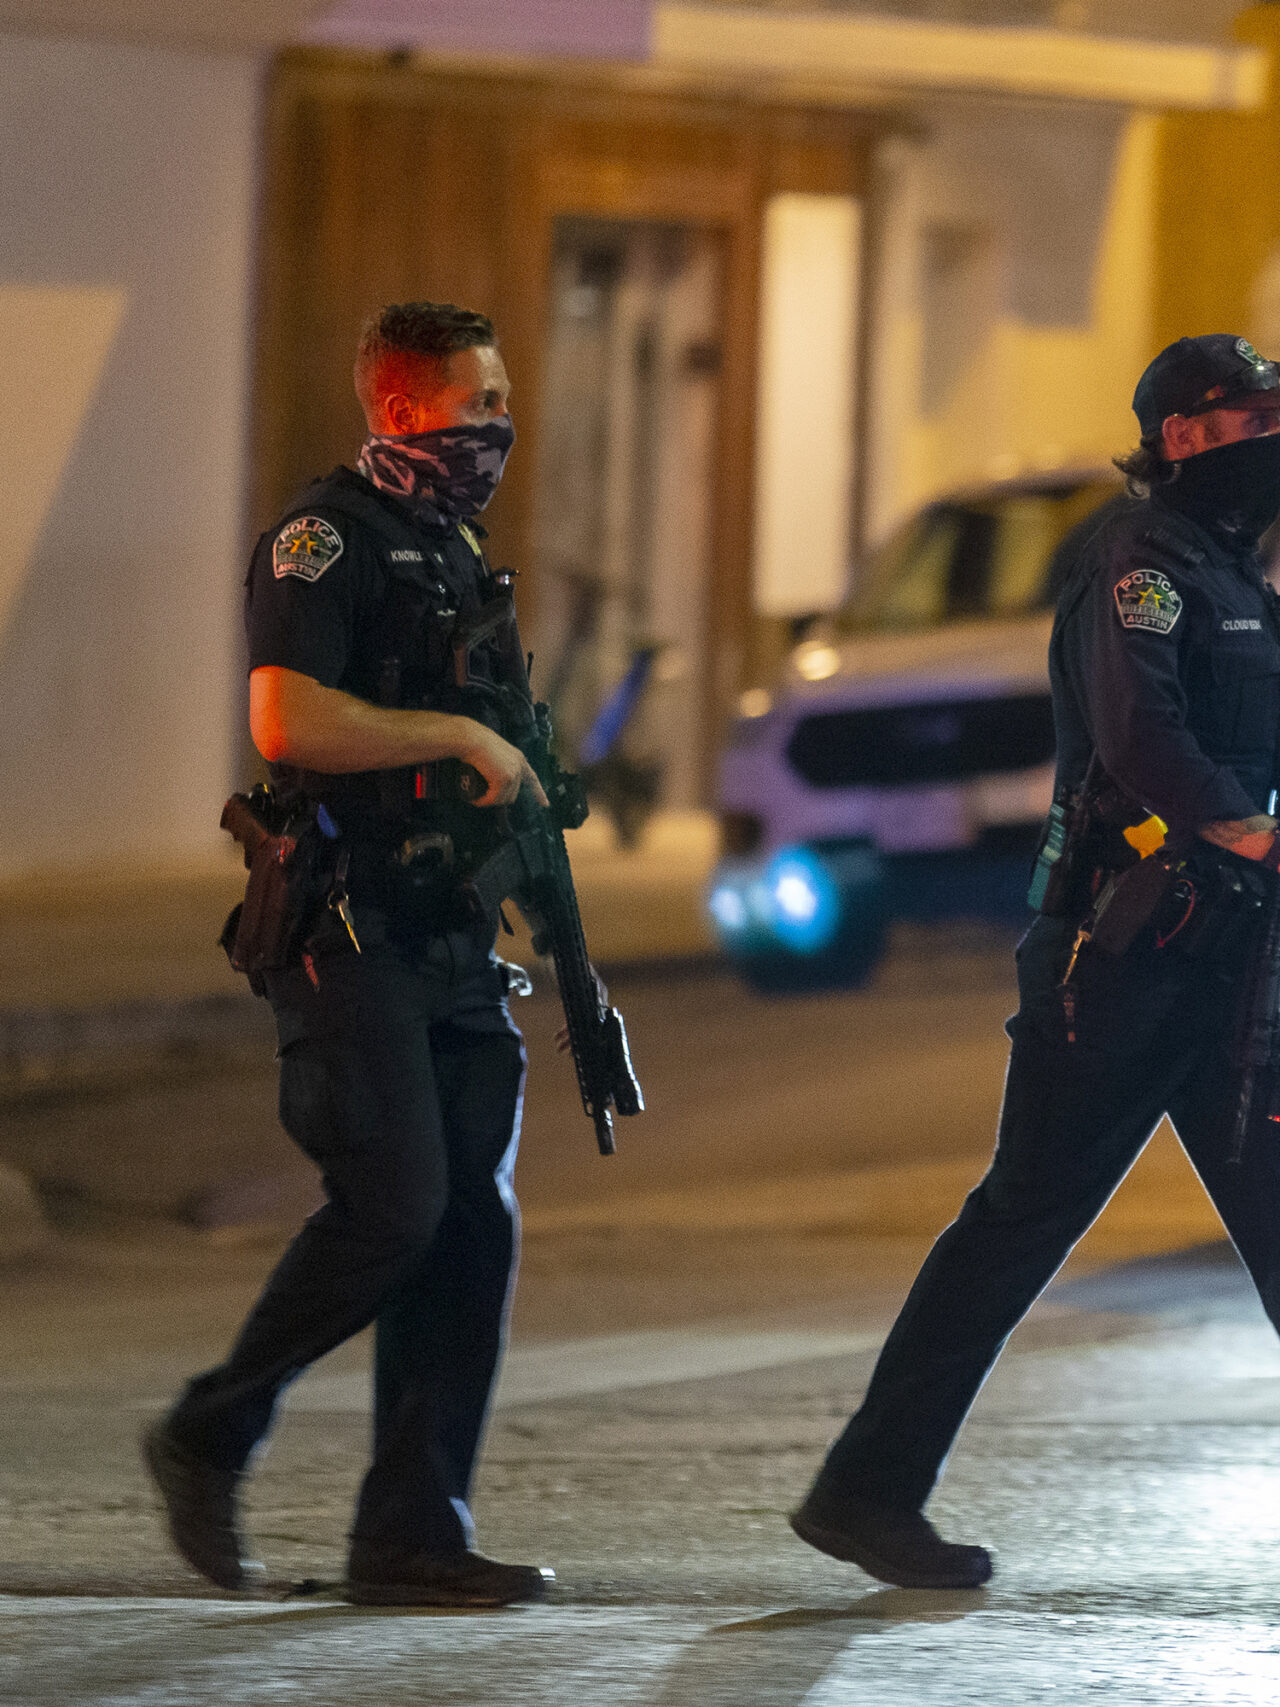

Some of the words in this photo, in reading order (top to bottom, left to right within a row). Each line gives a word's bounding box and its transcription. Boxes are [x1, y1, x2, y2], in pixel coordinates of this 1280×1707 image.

[279, 519, 339, 548] POLICE
[277, 562, 316, 577] AUSTIN
[1119, 573, 1179, 603] POLICE
[1127, 614, 1168, 629] AUSTIN
